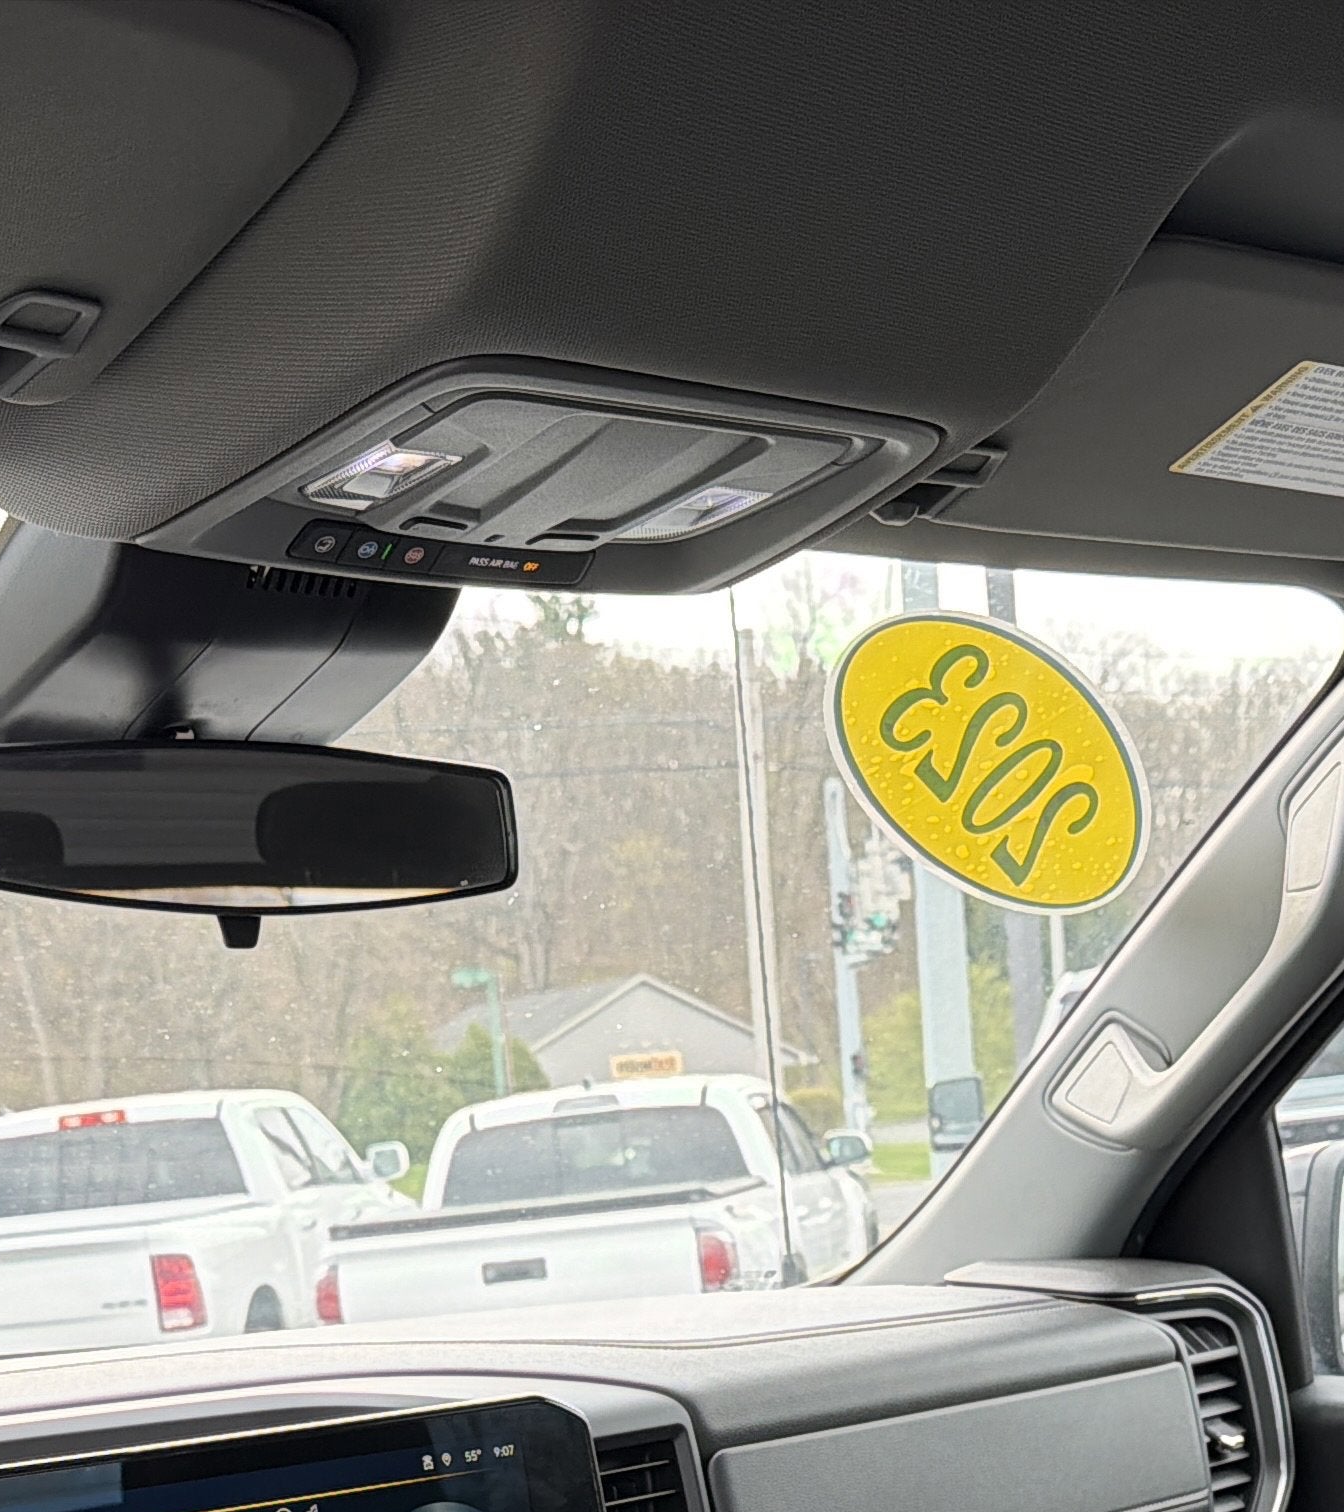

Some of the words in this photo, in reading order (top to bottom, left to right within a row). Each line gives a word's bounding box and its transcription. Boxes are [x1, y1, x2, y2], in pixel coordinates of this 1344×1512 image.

[468, 557, 488, 567] PASS
[488, 558, 502, 568] AIR
[522, 562, 540, 571] OFF
[493, 1444, 515, 1458] 9:07
